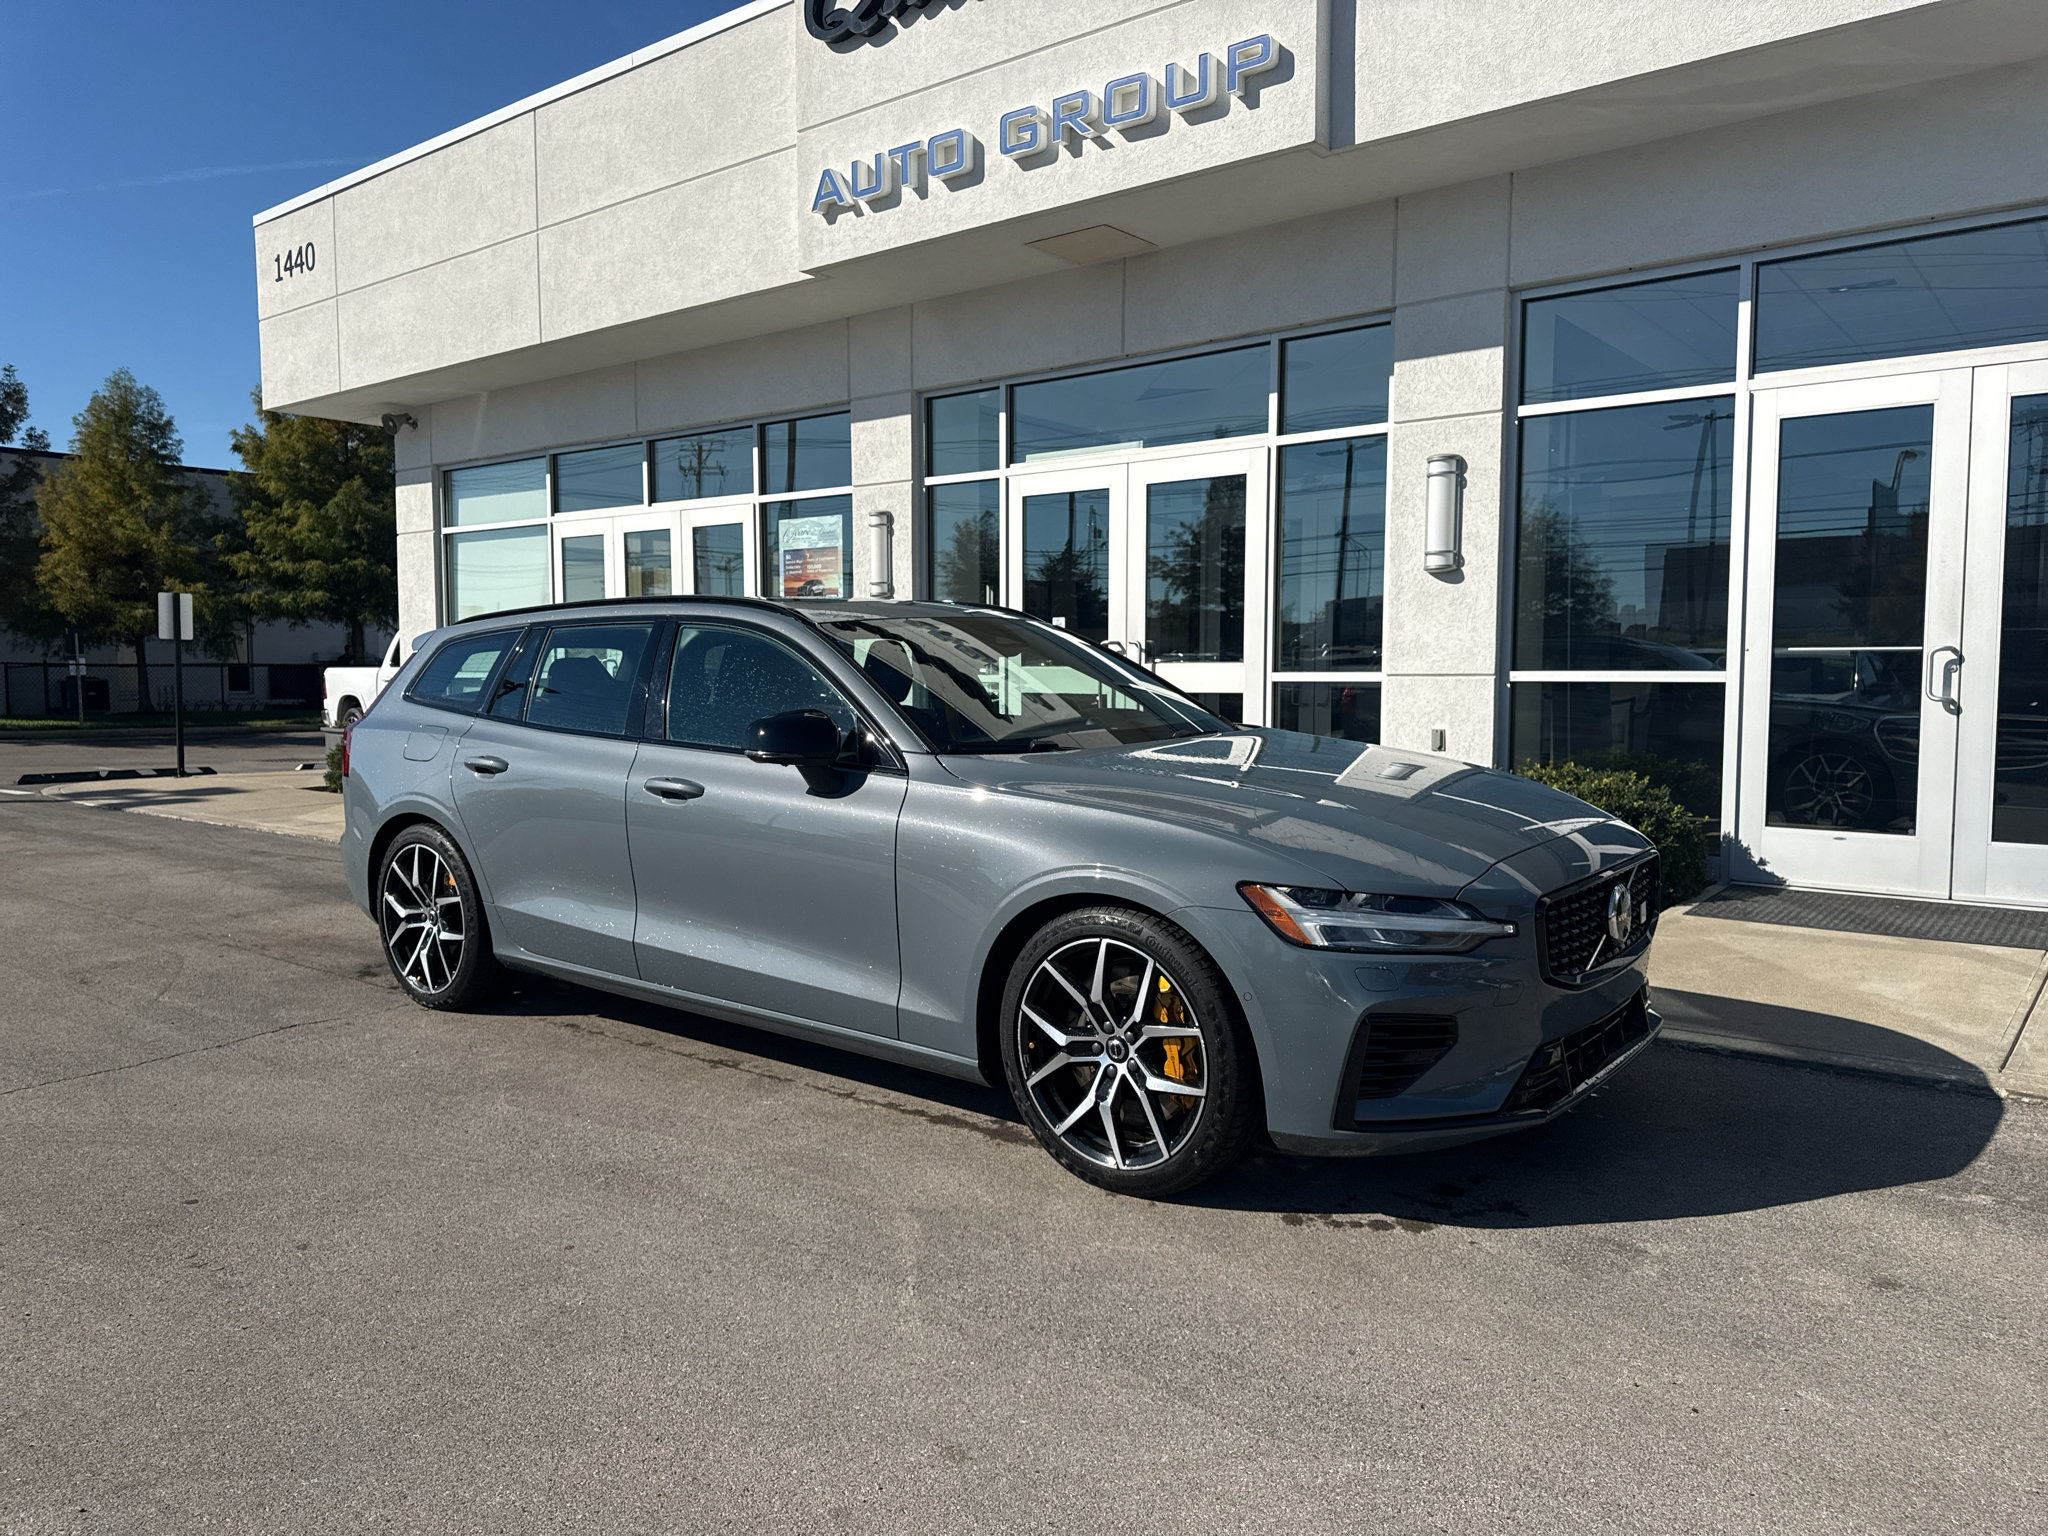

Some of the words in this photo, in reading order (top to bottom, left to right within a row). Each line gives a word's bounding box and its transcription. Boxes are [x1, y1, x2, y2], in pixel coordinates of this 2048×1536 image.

[811, 128, 975, 214] AUTO
[1000, 33, 1278, 158] GROUP
[274, 242, 316, 283] 1440
[1145, 935, 1197, 987] Continental
